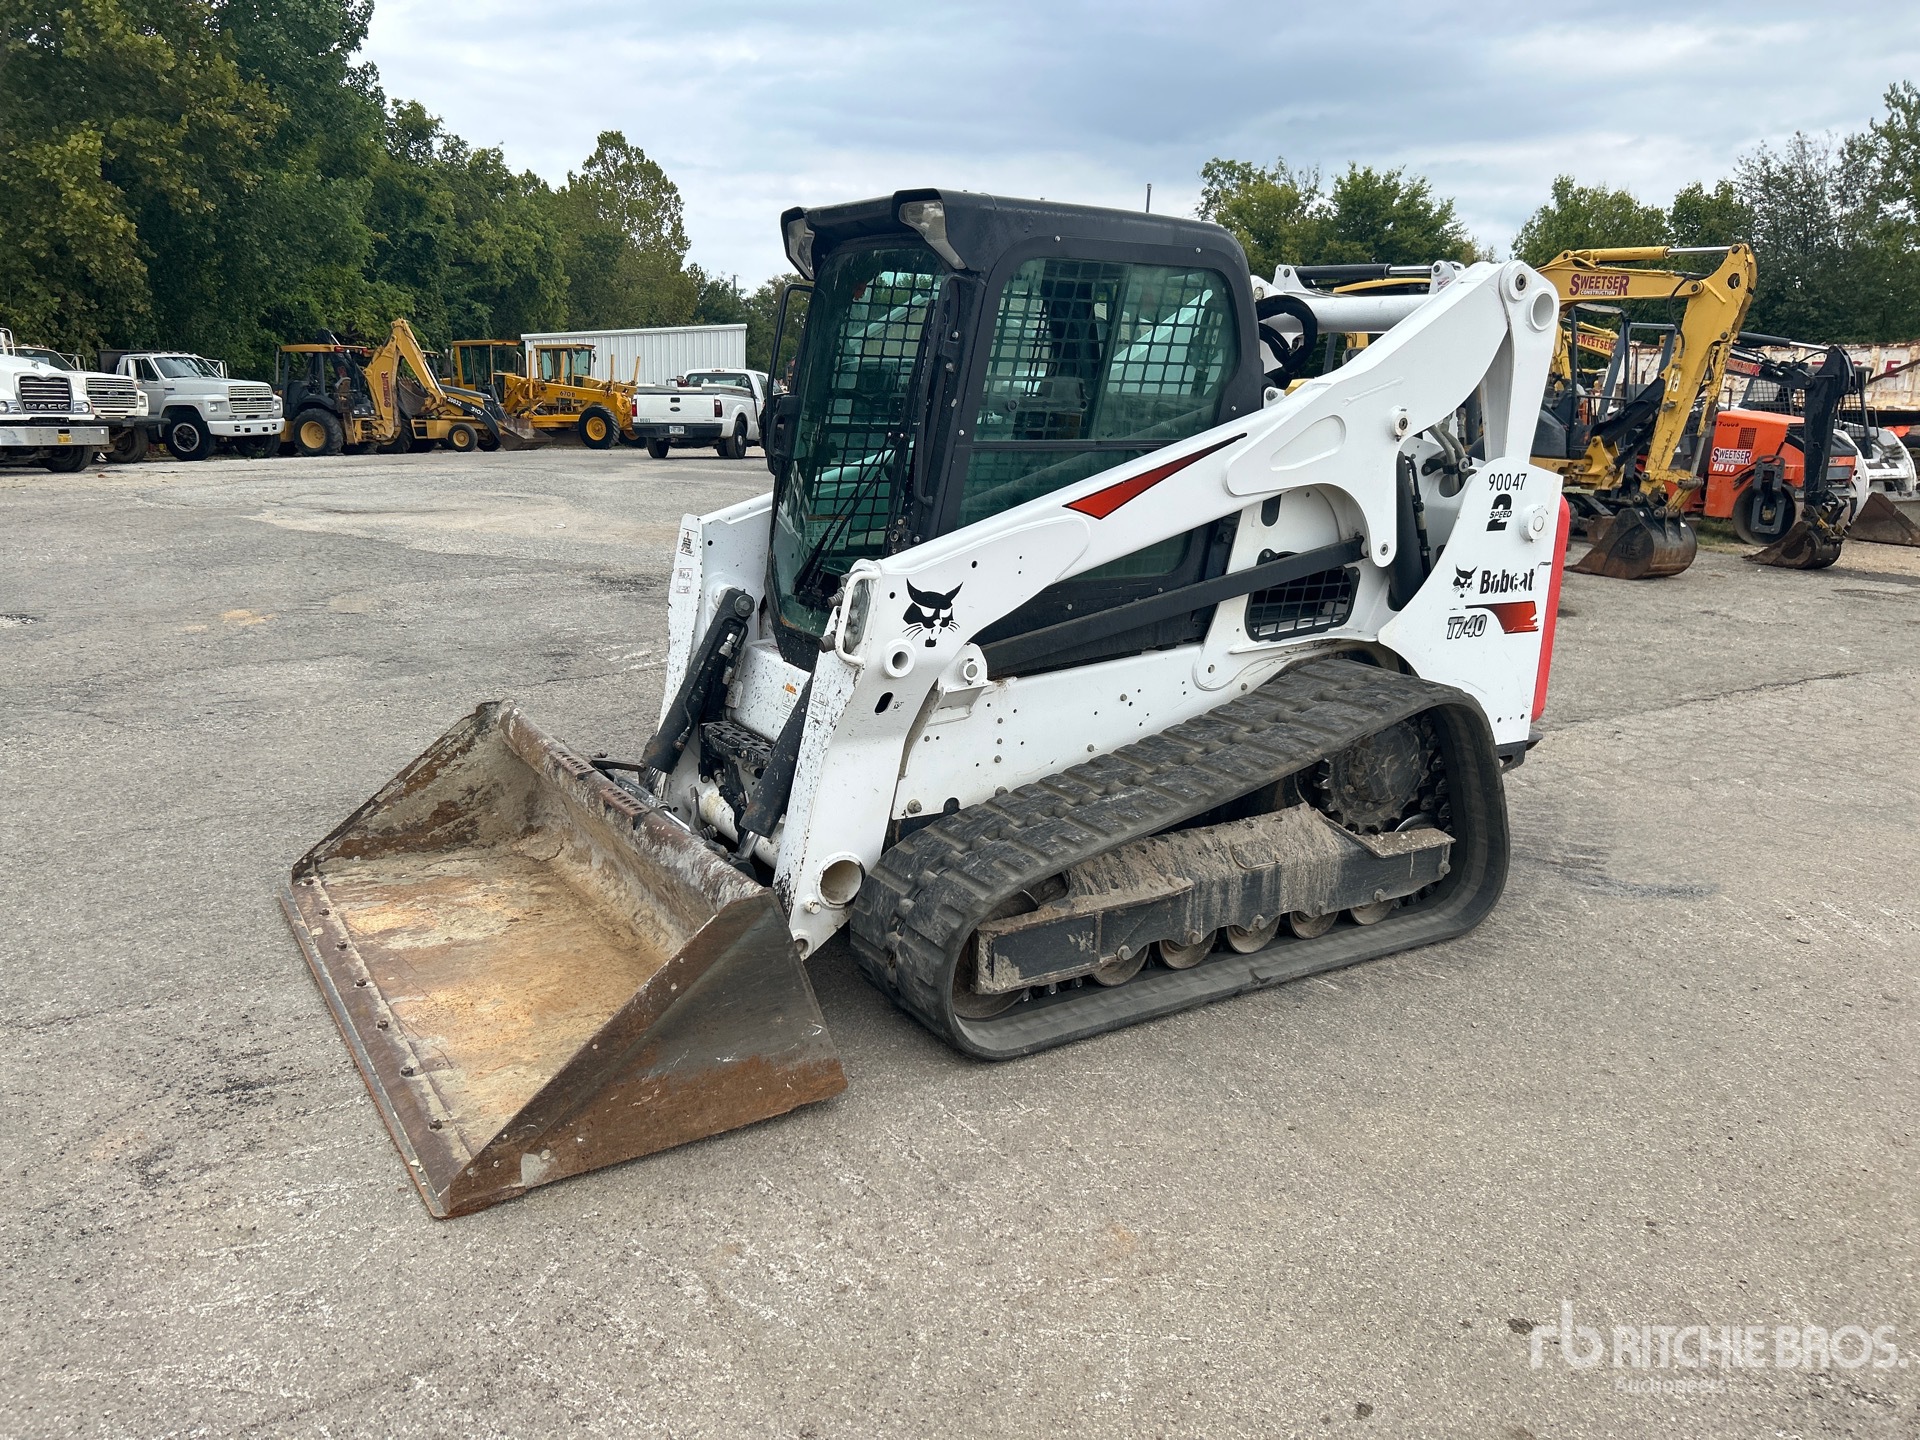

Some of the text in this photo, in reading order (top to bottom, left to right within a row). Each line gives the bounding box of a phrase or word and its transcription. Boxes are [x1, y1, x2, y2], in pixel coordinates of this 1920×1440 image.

[1569, 273, 1630, 296] SWEETSER
[1712, 447, 1752, 464] SWEETSER
[1488, 473, 1527, 491] 90047
[1486, 493, 1512, 531] 2
[1489, 510, 1512, 519] SPEED
[1479, 569, 1535, 594] Bobcat
[1446, 614, 1488, 640] T740
